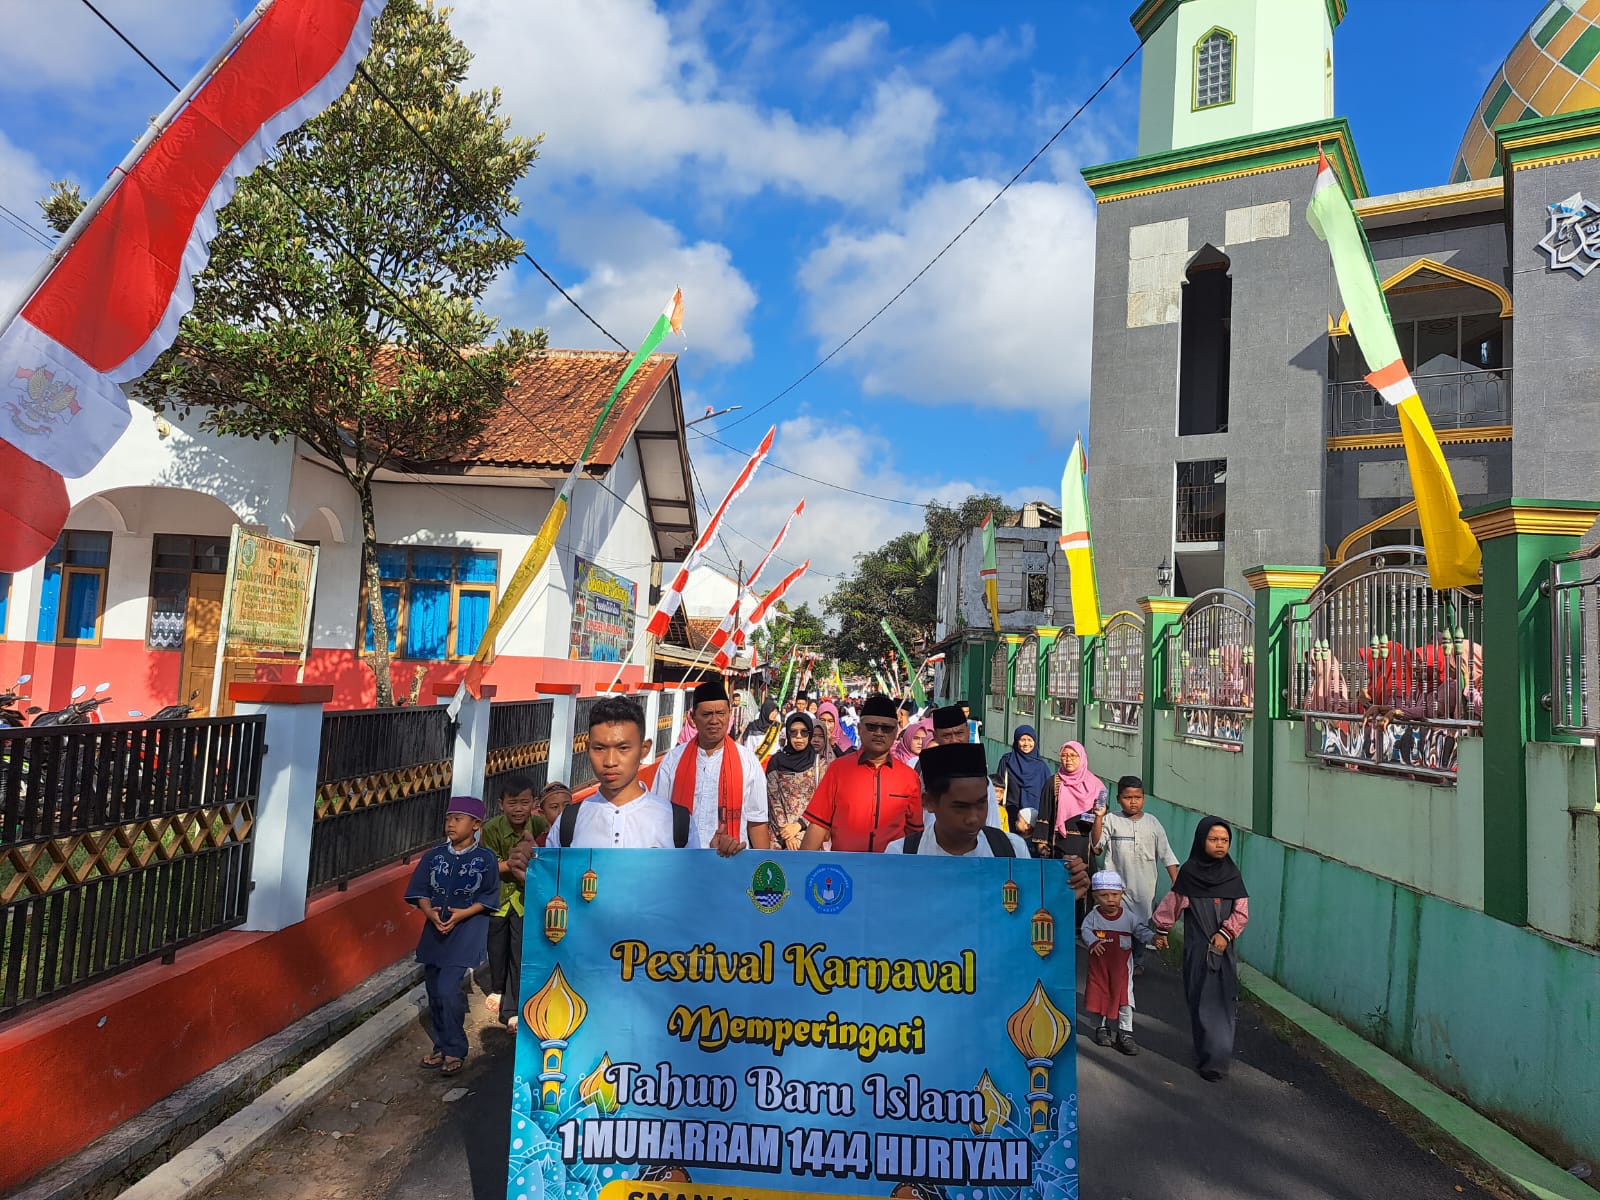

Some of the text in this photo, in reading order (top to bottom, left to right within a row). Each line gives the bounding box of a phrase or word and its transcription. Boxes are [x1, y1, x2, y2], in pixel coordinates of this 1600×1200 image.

[611, 940, 976, 995] Pestival Karnaval
[667, 1004, 926, 1062] Memperingati
[604, 1061, 987, 1125] Tahun Baru Islam
[558, 1118, 1033, 1187] 1 MUHARRAM 1444 HIJRIYAH
